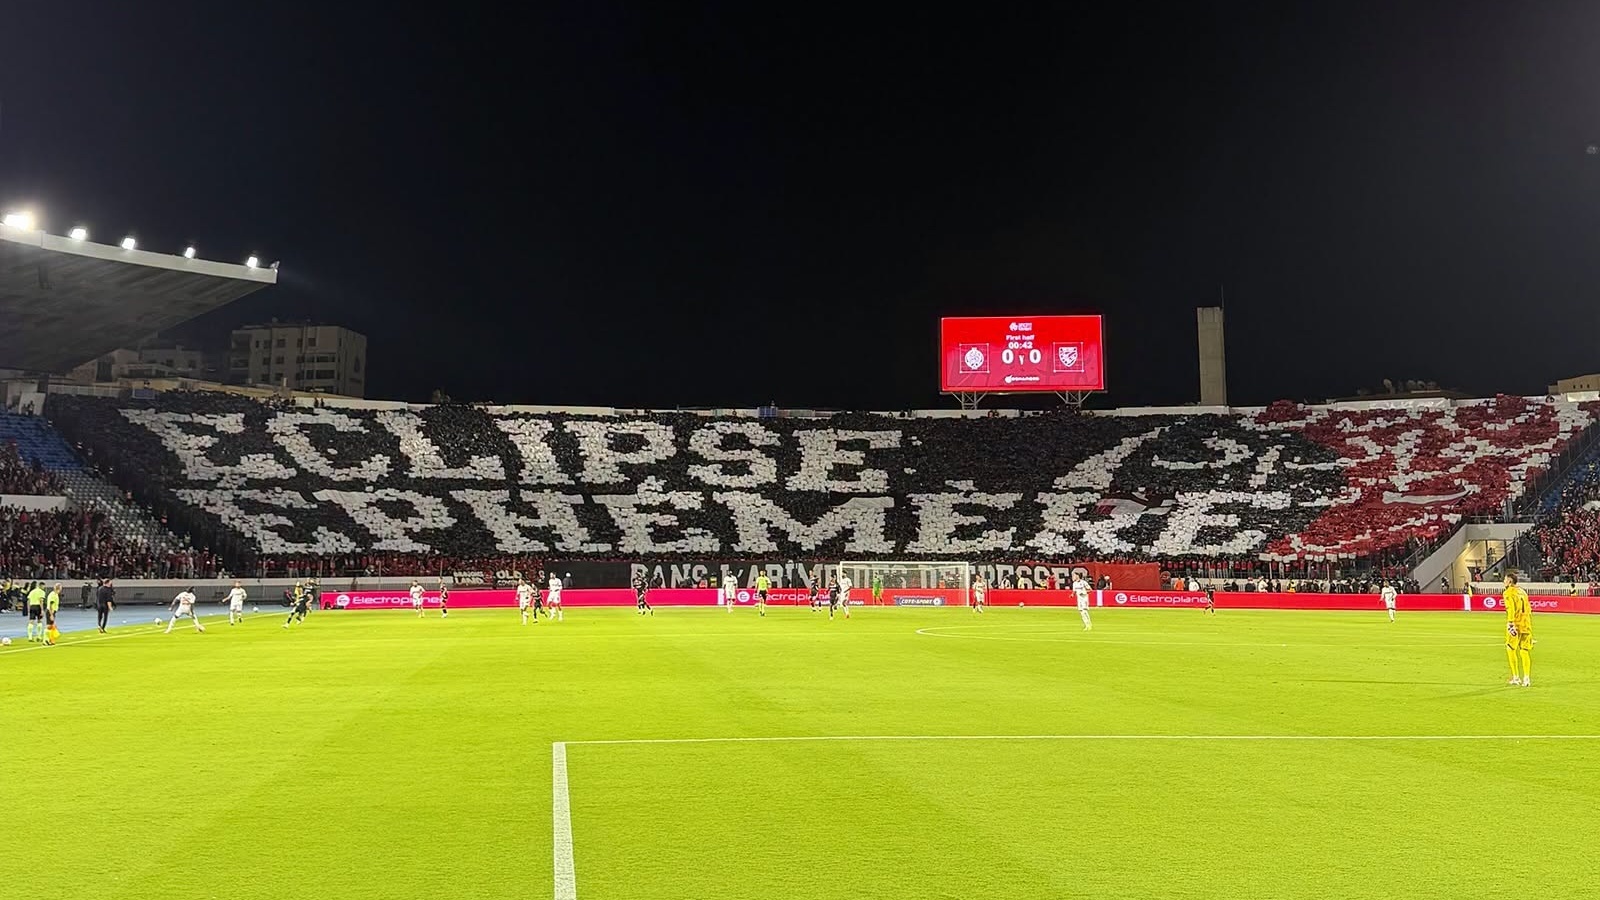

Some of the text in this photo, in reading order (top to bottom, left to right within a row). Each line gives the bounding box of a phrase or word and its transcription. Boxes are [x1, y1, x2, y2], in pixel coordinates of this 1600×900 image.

[1008, 342, 1033, 350] 00:42
[1002, 349, 1014, 364] 0
[1029, 349, 1041, 364] 0
[1129, 594, 1209, 605] Electroplane
